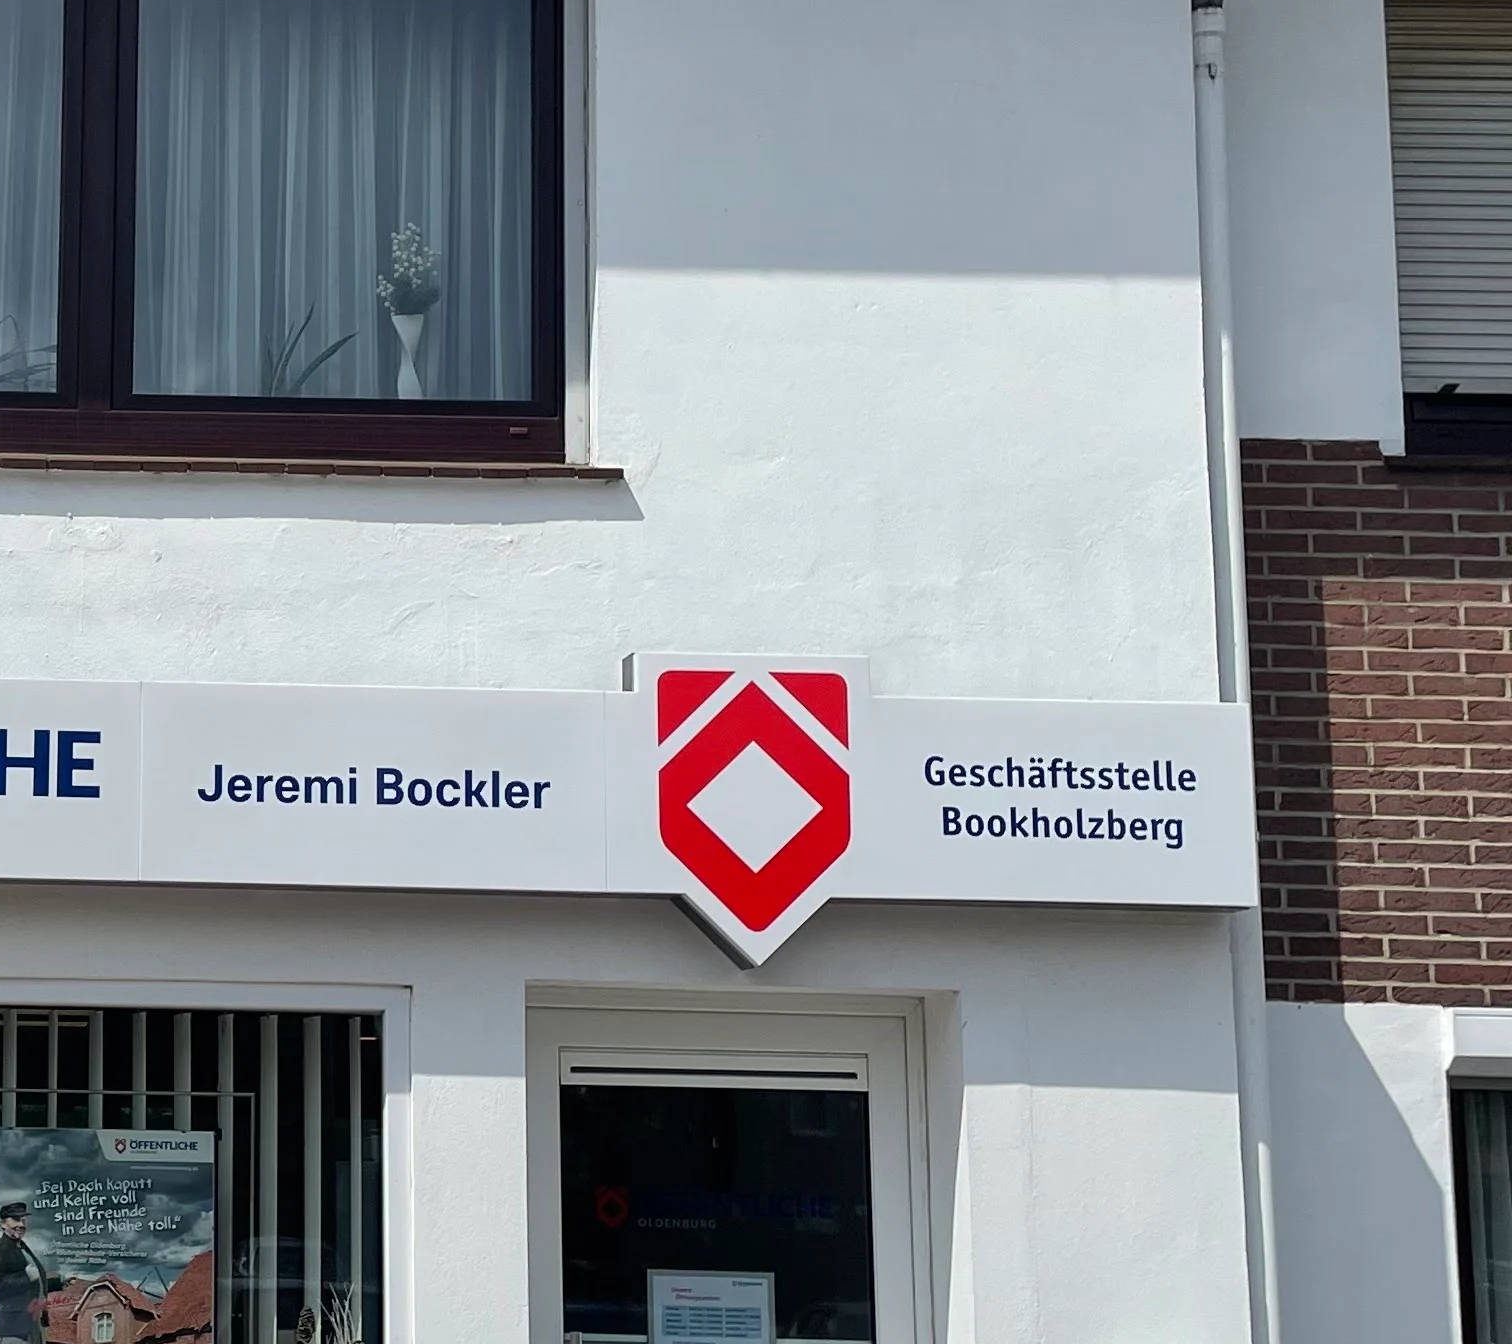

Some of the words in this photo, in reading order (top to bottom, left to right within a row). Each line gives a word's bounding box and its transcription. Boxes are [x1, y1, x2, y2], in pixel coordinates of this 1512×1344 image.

[925, 756, 1198, 794] Geschäftsstelle
[197, 764, 358, 806] Jeremi
[376, 768, 552, 811] Bockler
[942, 807, 1185, 851] Bookholzberg
[129, 1139, 199, 1151] ÖFFENTLICHE
[68, 1179, 103, 1193] Dach
[106, 1177, 152, 1194] kaputt
[33, 1195, 60, 1209] und
[63, 1193, 107, 1208] Keller
[112, 1190, 136, 1204] voll
[54, 1208, 84, 1222] sind
[89, 1205, 147, 1220] Freunde
[62, 1223, 75, 1236] in
[79, 1223, 104, 1235] der
[108, 1218, 143, 1234] Nähe
